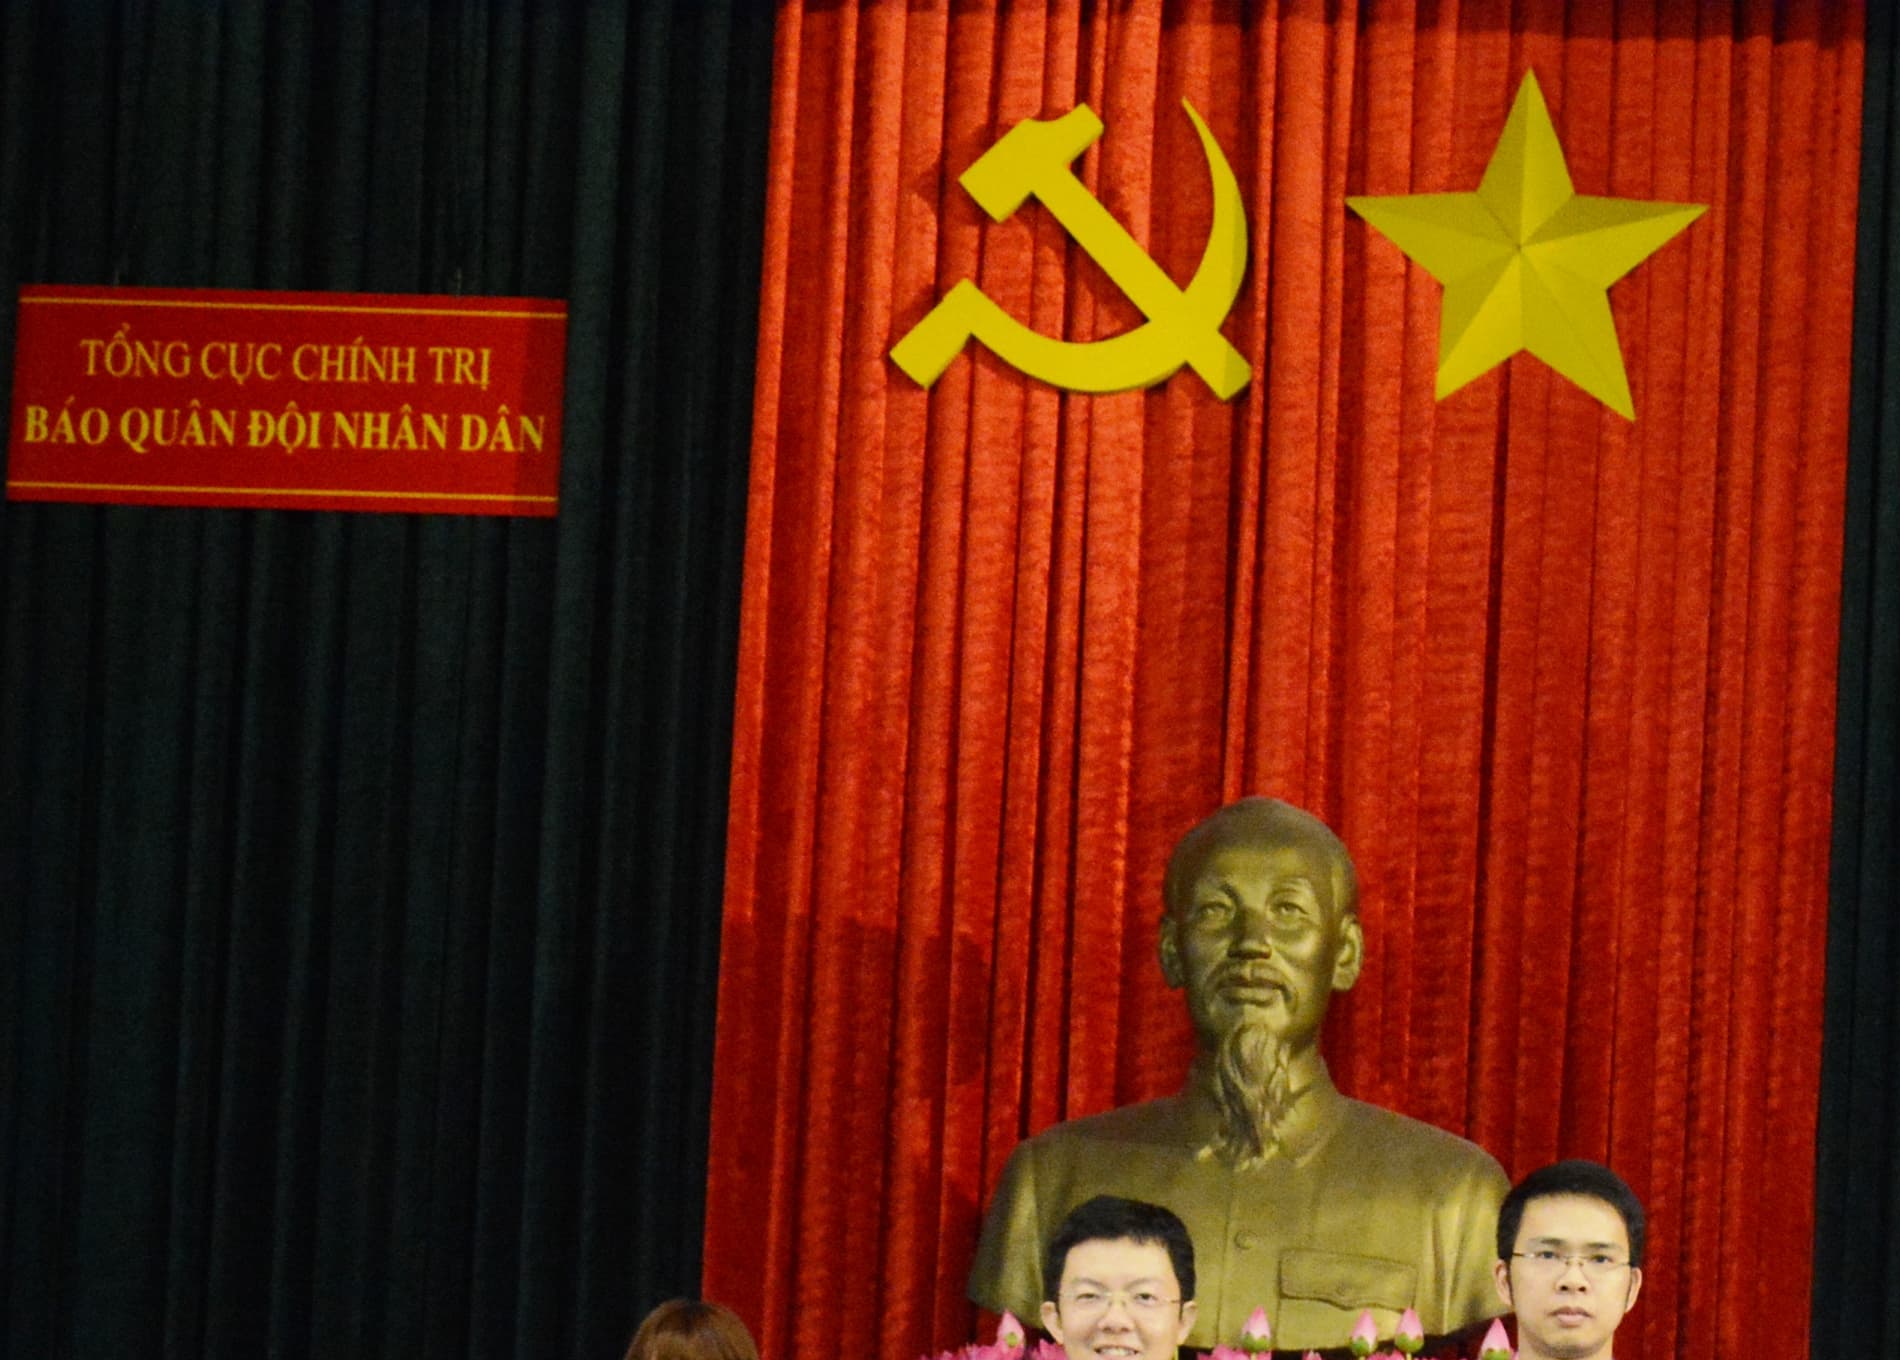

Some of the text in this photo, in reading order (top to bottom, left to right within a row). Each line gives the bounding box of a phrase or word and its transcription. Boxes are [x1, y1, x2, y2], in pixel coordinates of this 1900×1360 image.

[80, 322, 491, 391] TỔNG CỤC CHÍNH TRỊ
[24, 396, 545, 455] BÁO QUÂN ĐỘI NHÂN DÂN
